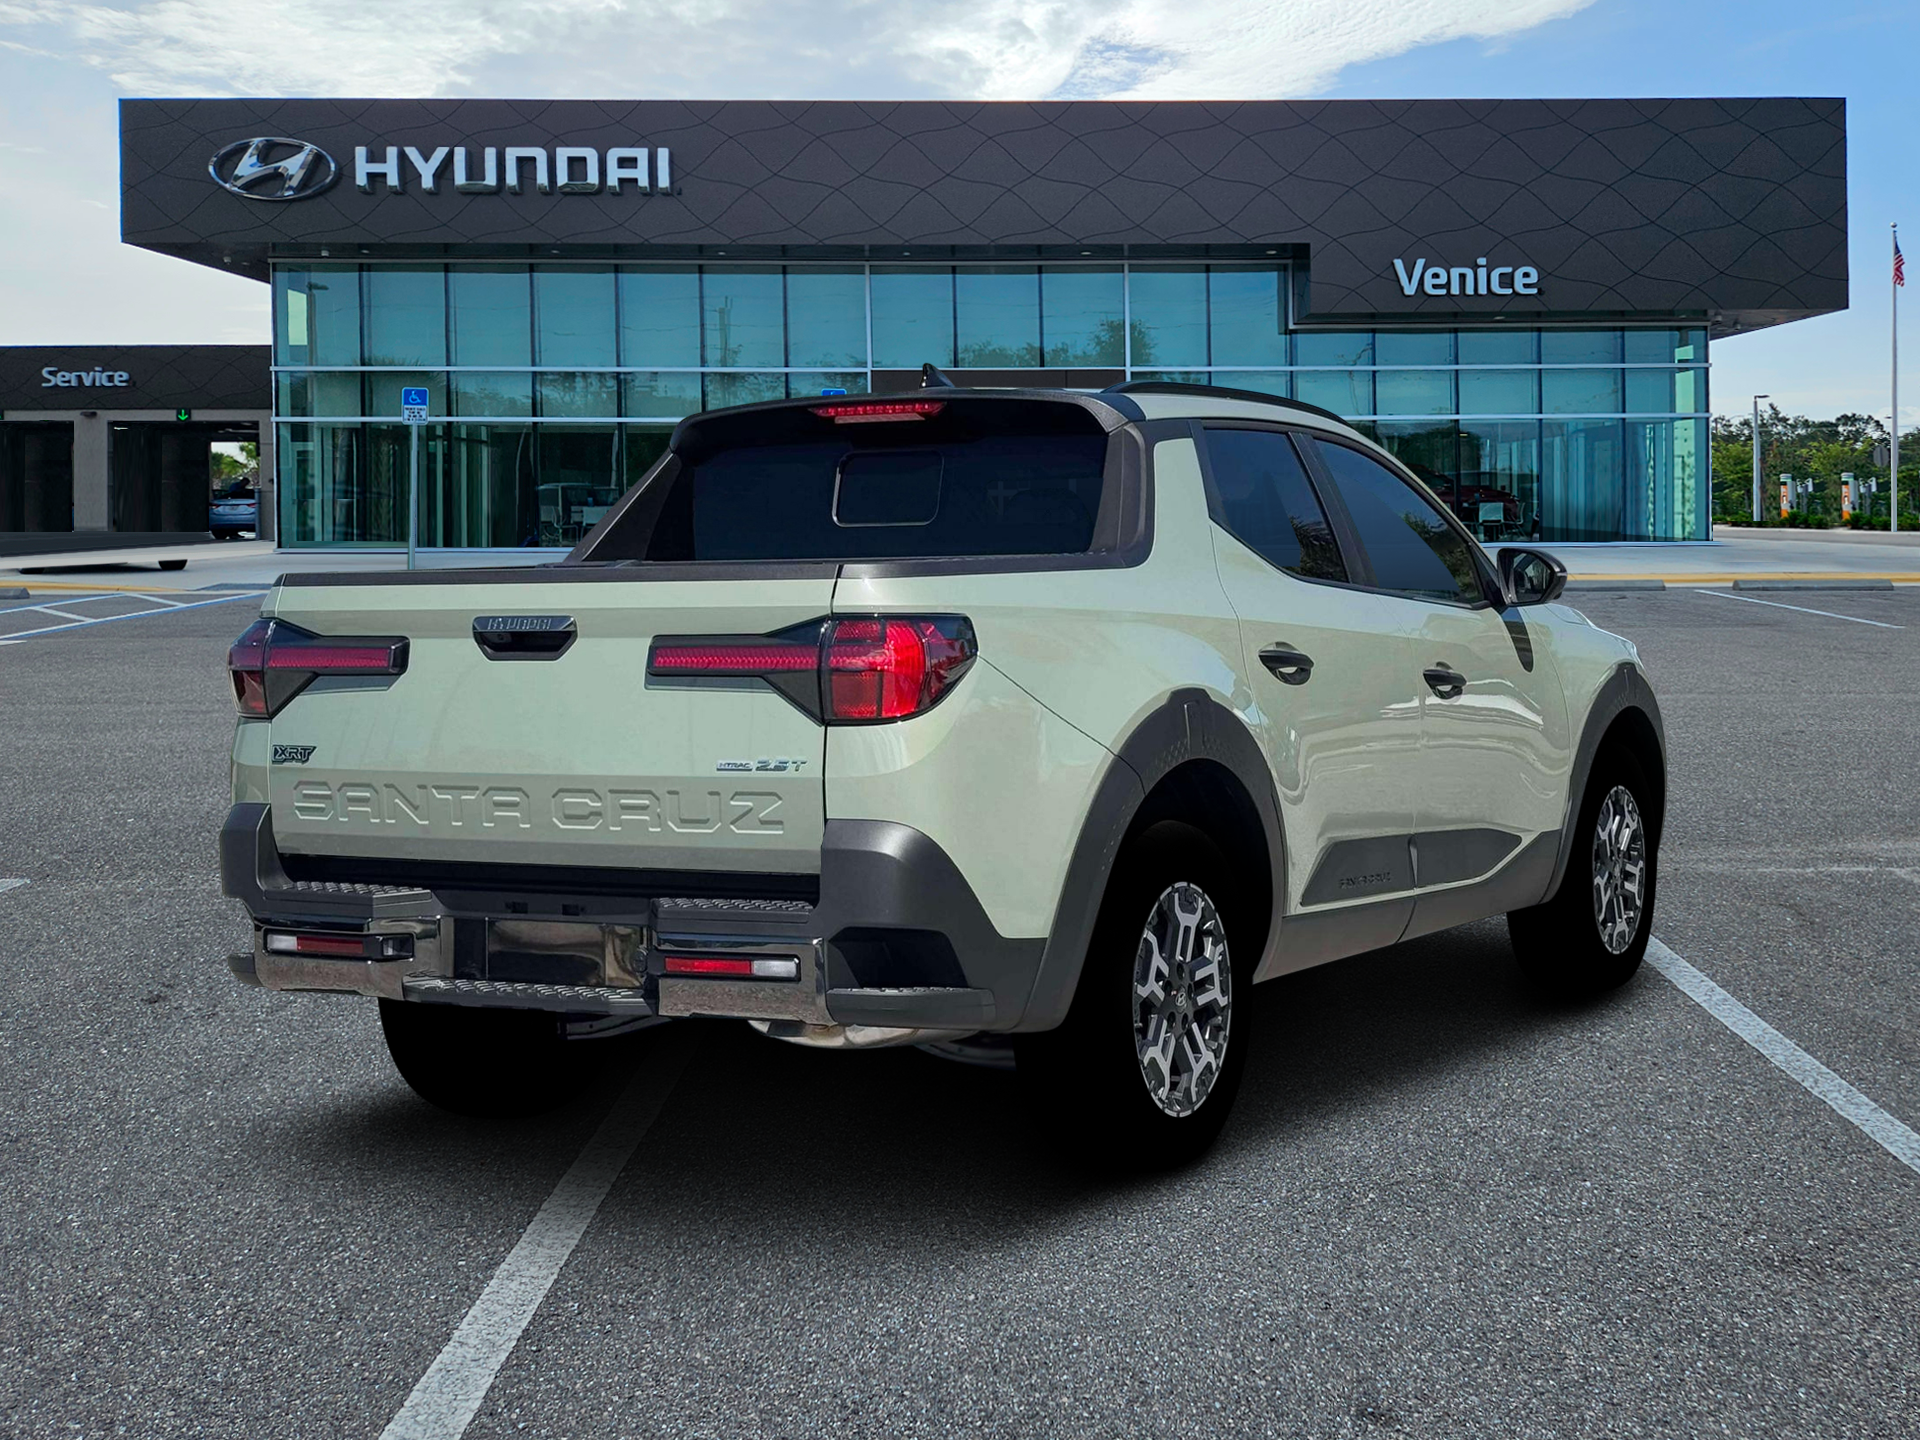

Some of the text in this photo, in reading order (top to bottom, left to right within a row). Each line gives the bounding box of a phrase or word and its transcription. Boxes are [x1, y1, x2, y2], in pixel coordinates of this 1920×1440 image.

[355, 146, 672, 194] HYUNDAI
[1393, 257, 1539, 296] Venice
[41, 366, 130, 387] Service
[487, 618, 552, 631] HYUNDAI
[273, 745, 316, 762] XRT
[718, 761, 752, 770] HTRAC
[293, 780, 784, 835] SANTA CRUZ
